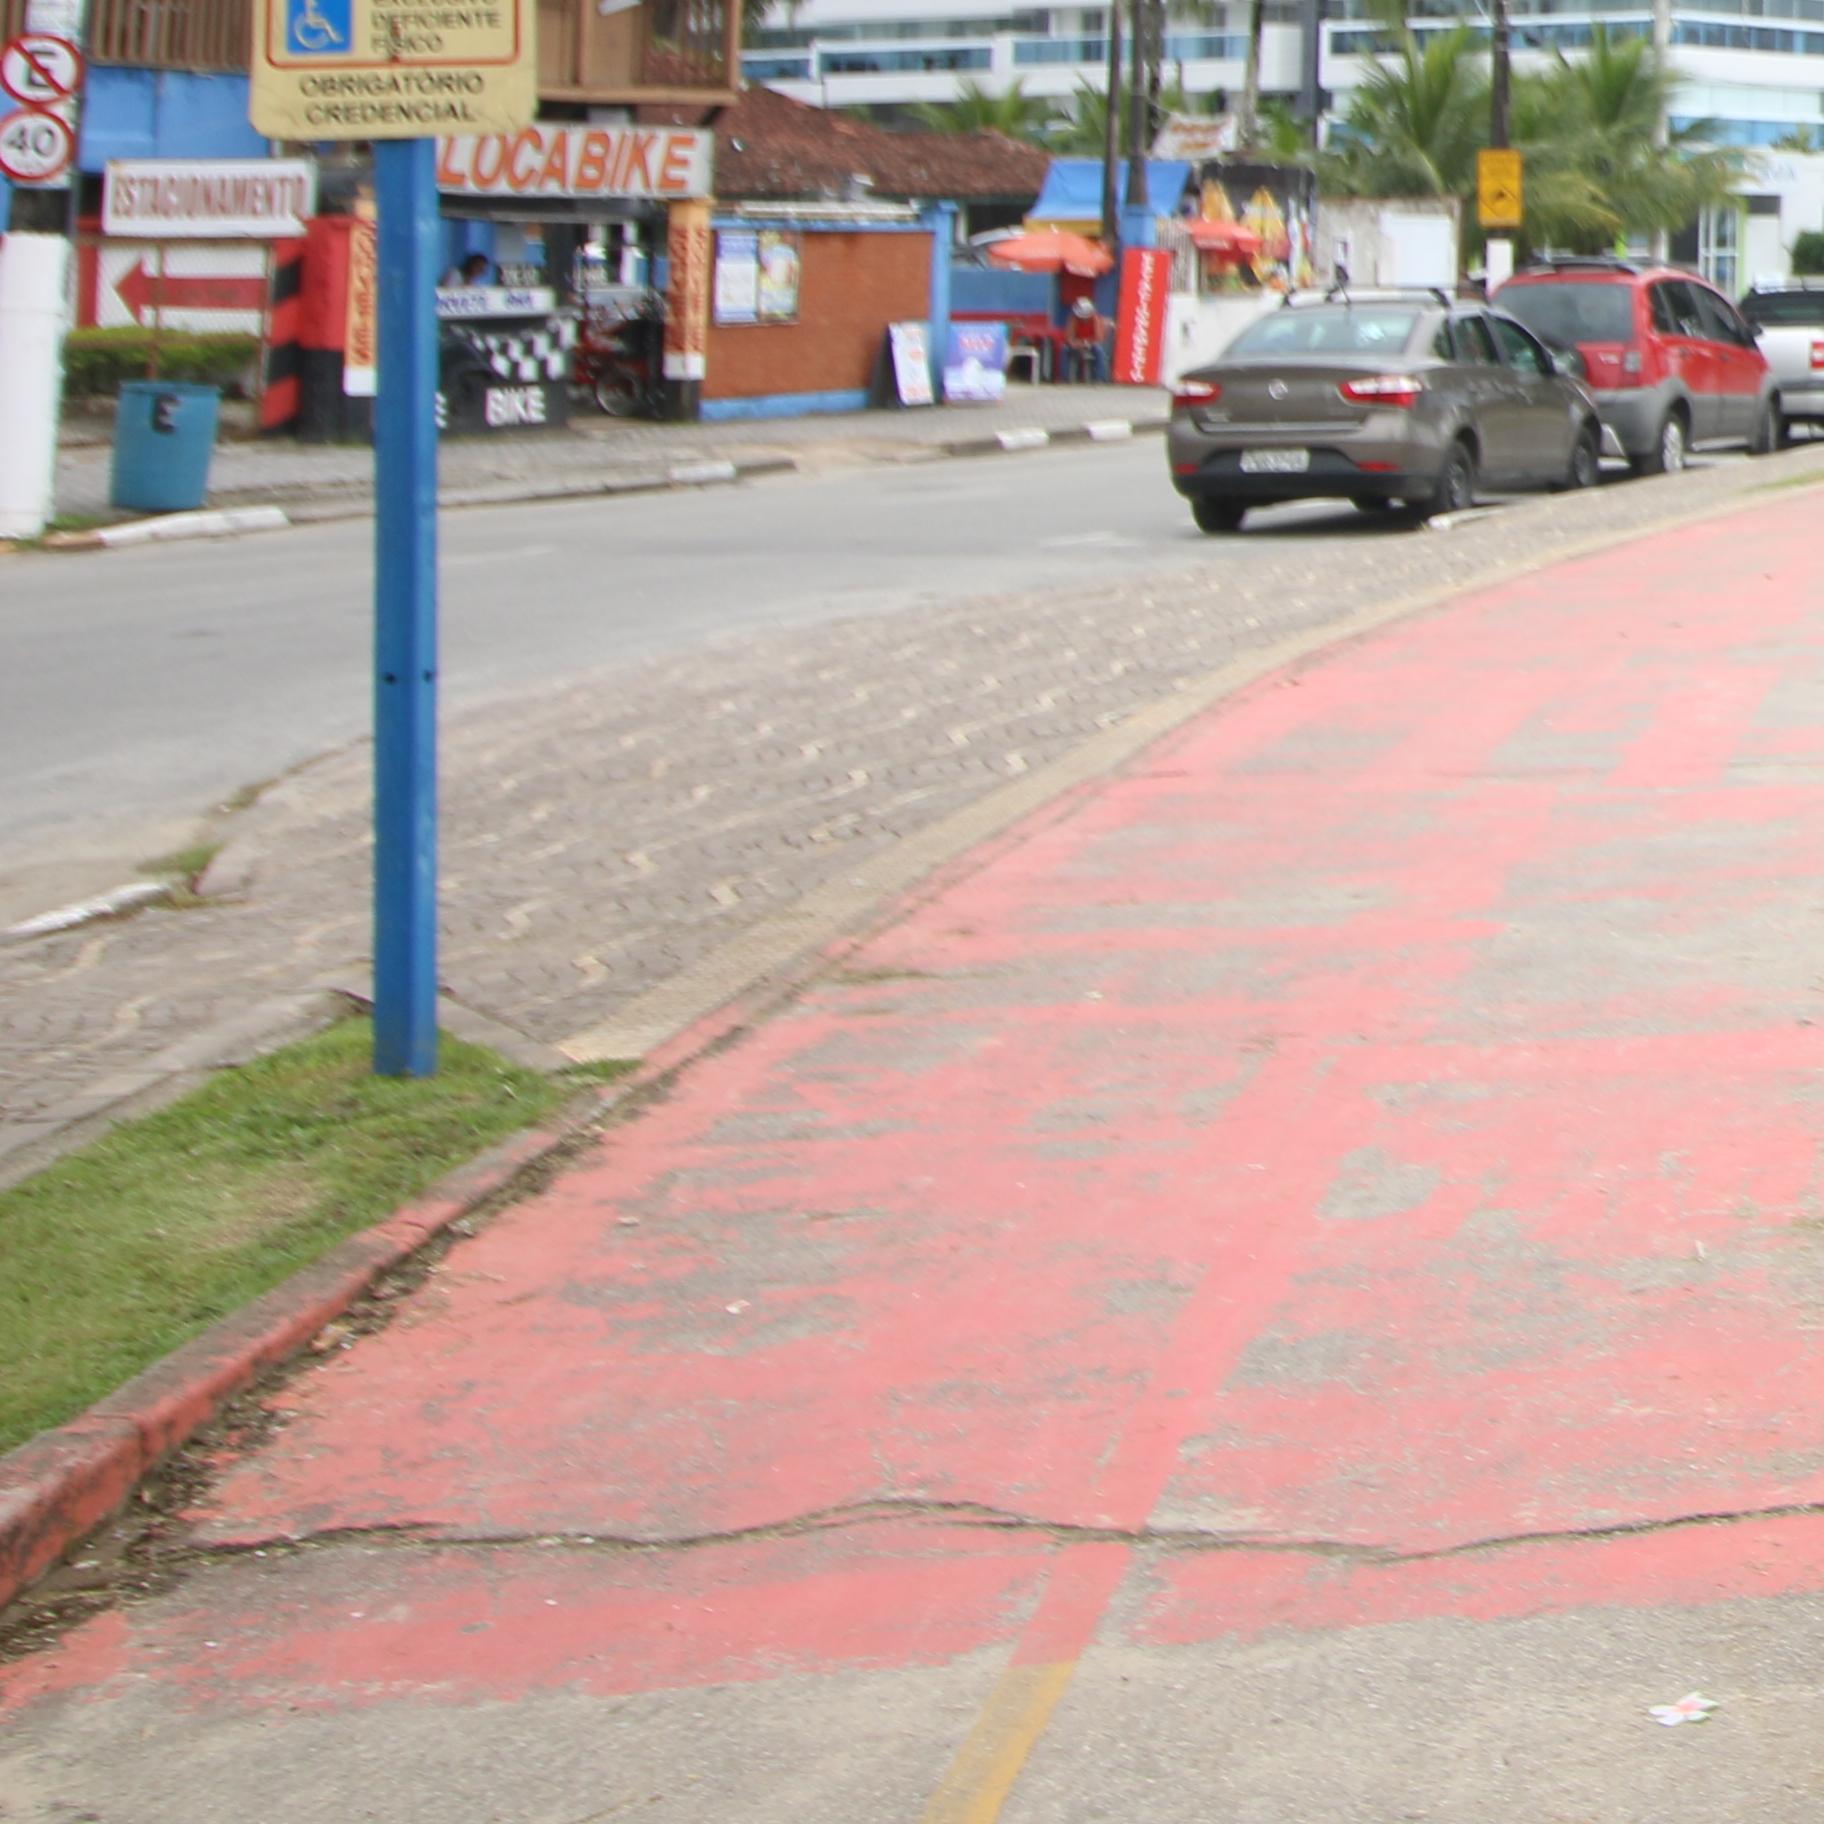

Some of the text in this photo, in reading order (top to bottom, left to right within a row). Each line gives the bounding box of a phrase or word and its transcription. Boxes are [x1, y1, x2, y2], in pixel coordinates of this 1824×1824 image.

[371, 10, 502, 29] DEFICIENTE
[299, 69, 485, 97] OBRIGATÓRIO
[305, 99, 476, 124] CREDENCIAL
[7, 128, 55, 158] 40
[437, 127, 696, 192] LOCABIKE
[112, 175, 304, 218] ESTACIONAMENTO
[486, 387, 546, 427] BIKE
